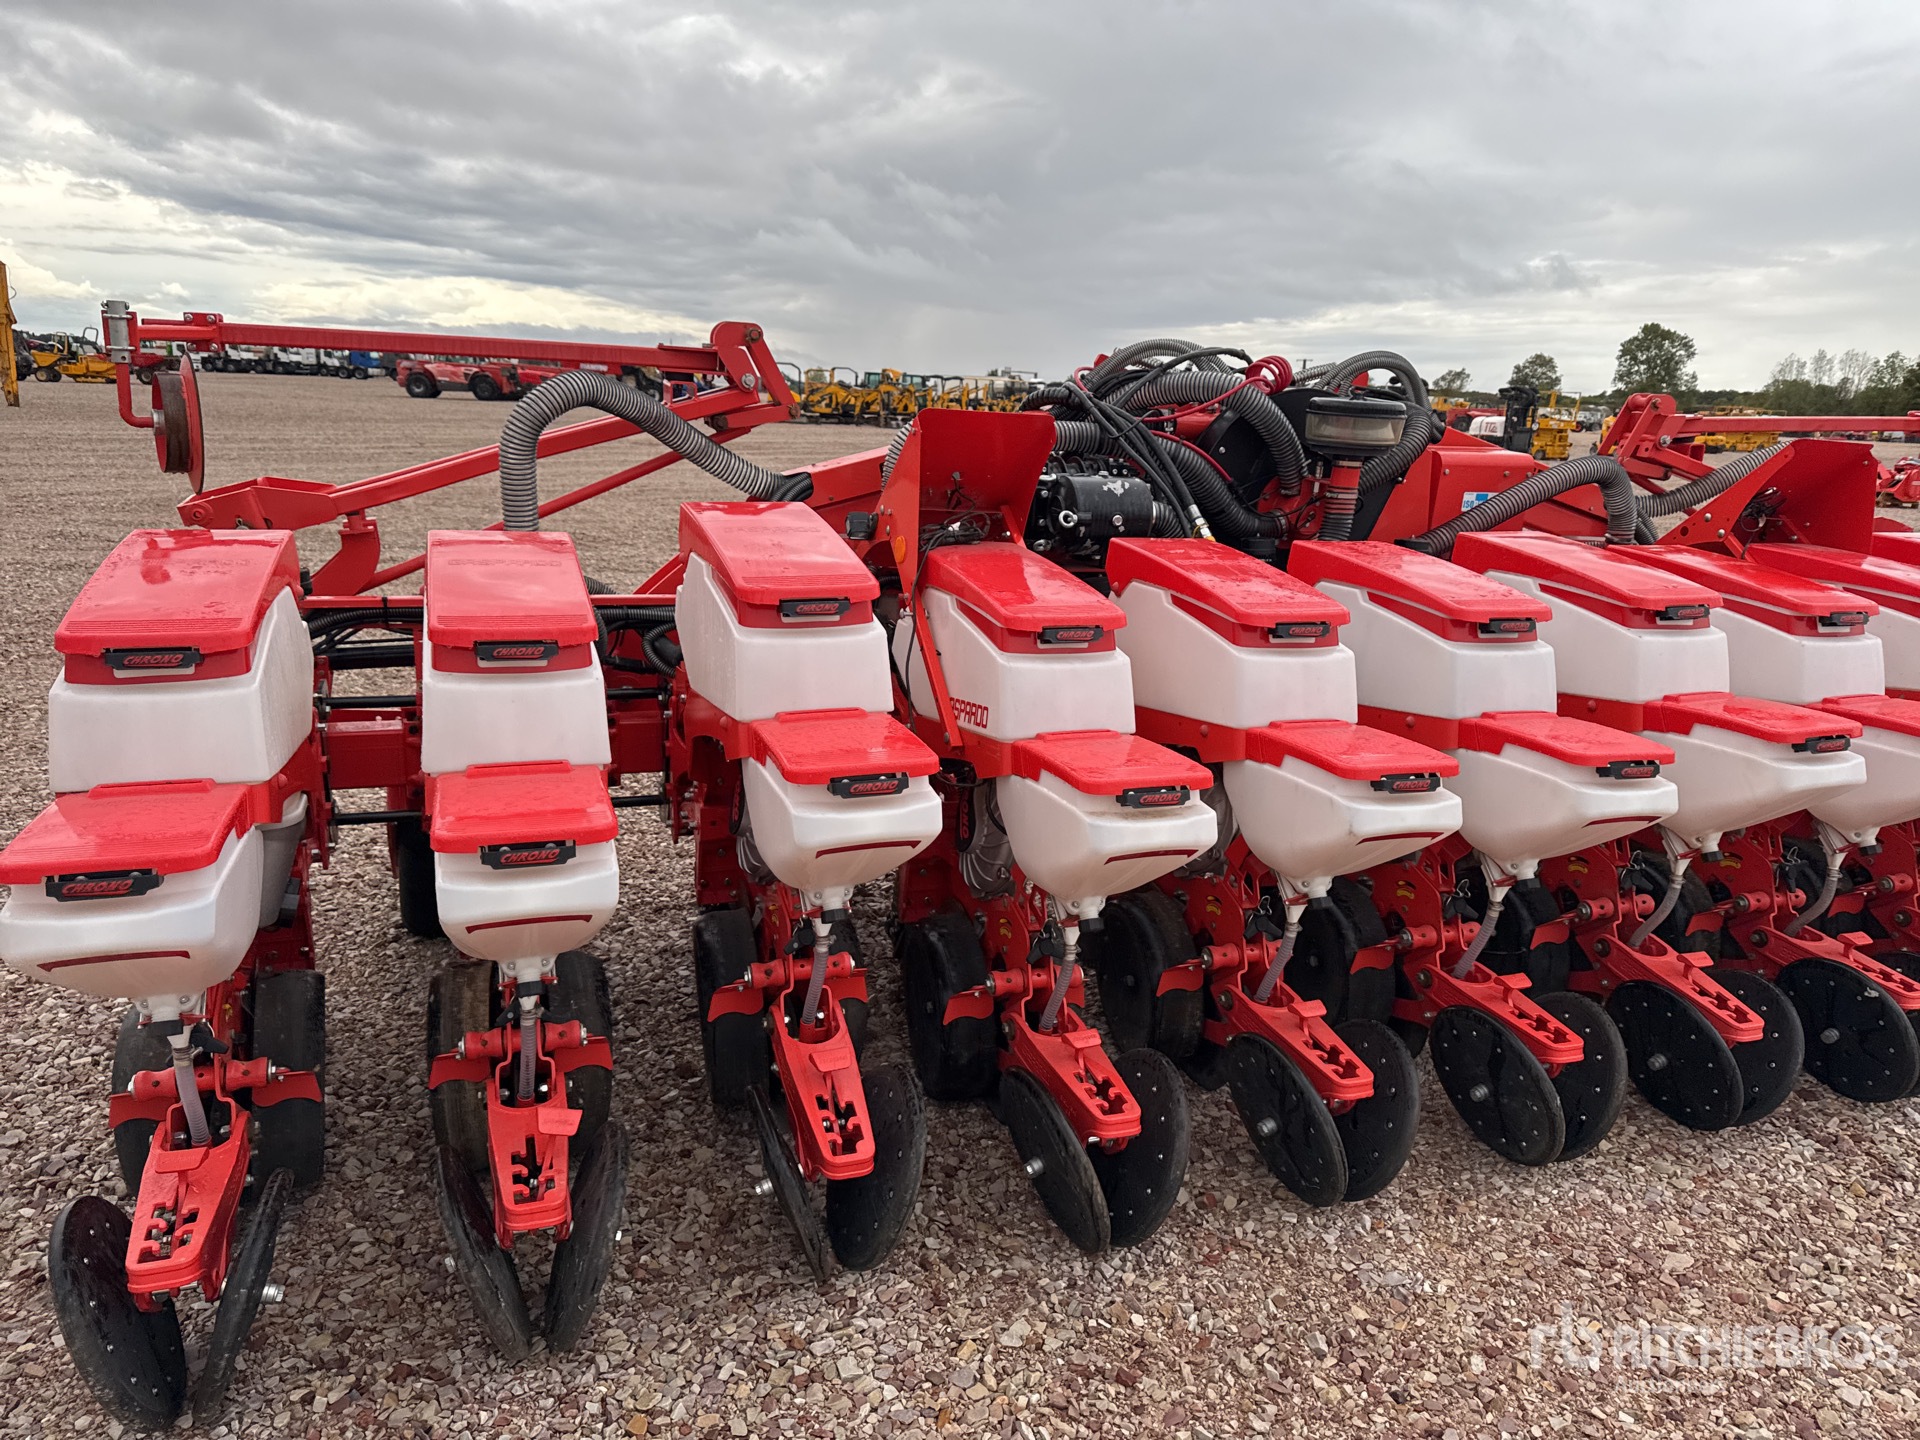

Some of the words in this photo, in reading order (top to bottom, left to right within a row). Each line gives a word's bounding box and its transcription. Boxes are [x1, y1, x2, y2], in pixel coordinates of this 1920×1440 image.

[796, 604, 840, 614] CHRONO
[1057, 630, 1095, 640] CHRONO
[1289, 627, 1323, 636] CHRONO
[493, 646, 545, 658] CHRONO
[123, 654, 184, 667] CHRONO
[950, 697, 989, 729] SPARDO
[1621, 767, 1654, 777] CHRONO
[850, 781, 898, 793] CHRONO
[1392, 779, 1431, 790] CHRONO
[1140, 793, 1182, 803] CHRONO
[500, 849, 561, 863] CHRONO
[61, 880, 133, 895] CHRONO
